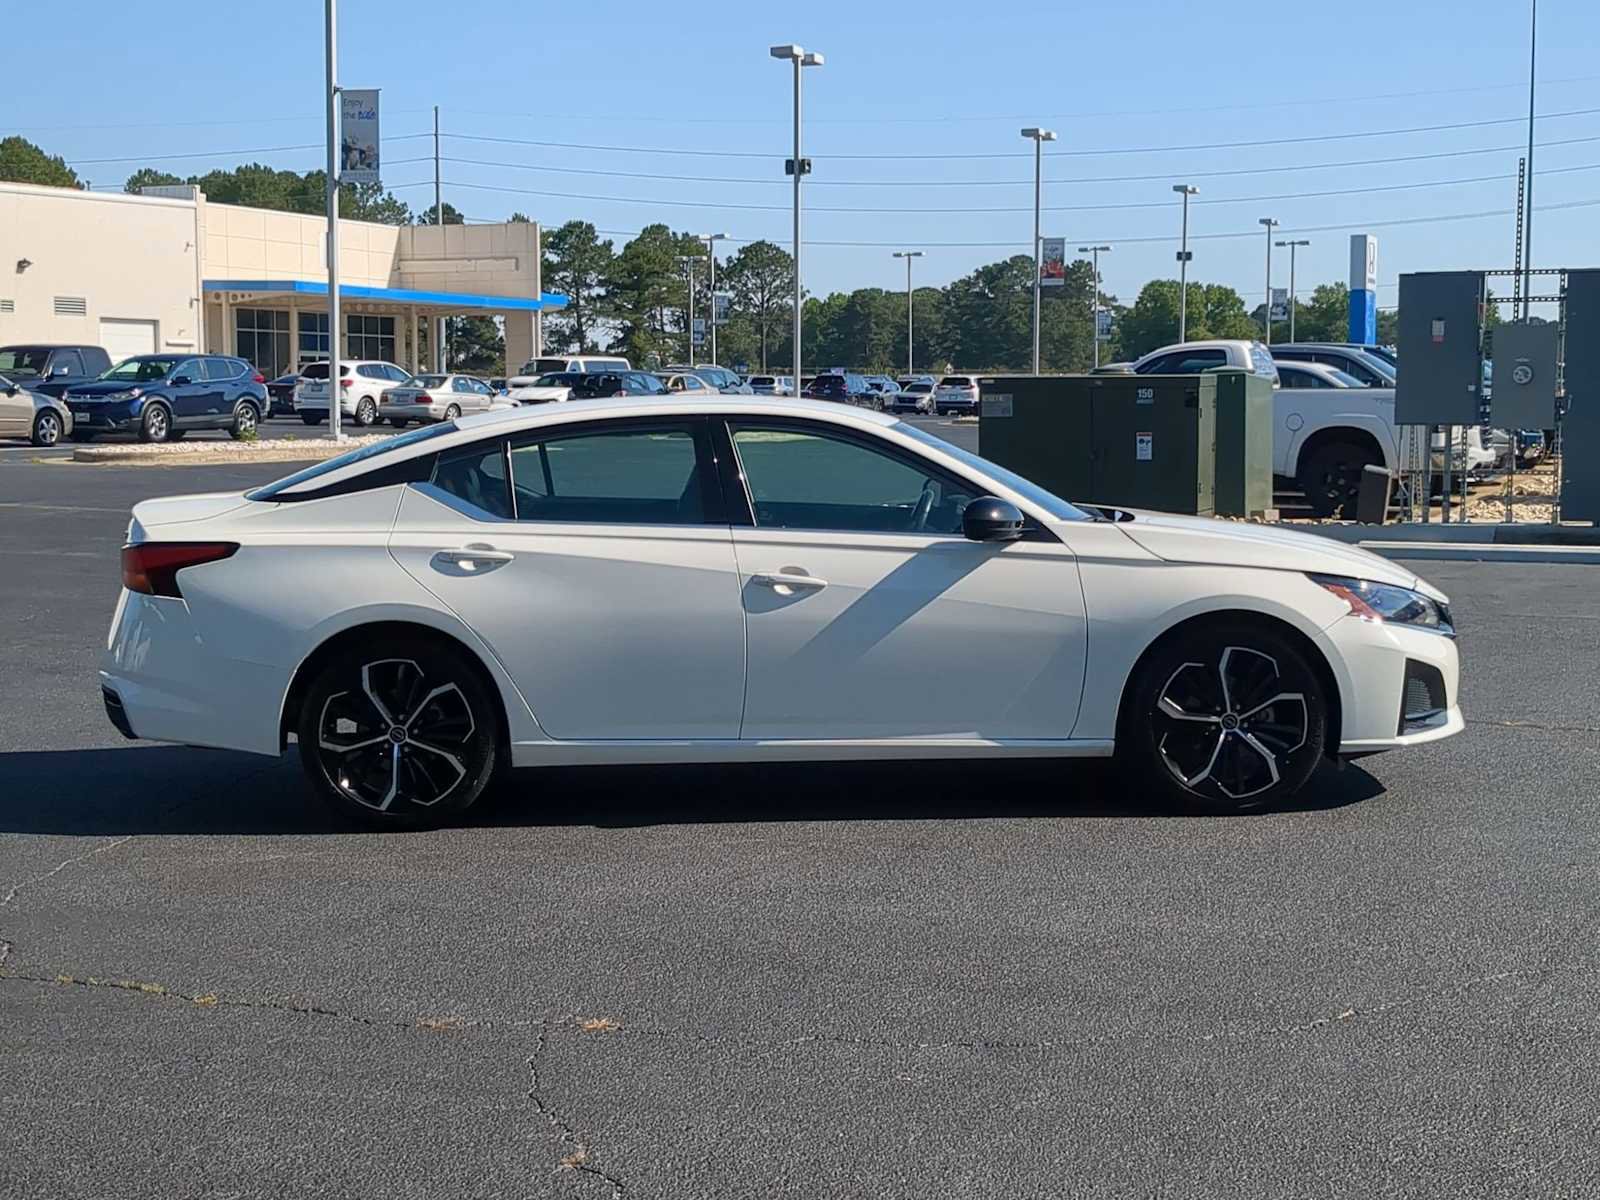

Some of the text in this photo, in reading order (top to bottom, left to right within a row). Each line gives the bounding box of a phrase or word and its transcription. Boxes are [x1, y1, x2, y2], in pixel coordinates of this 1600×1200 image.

[343, 98, 363, 108] Enjoy
[343, 111, 356, 120] the
[1137, 387, 1153, 398] 150
